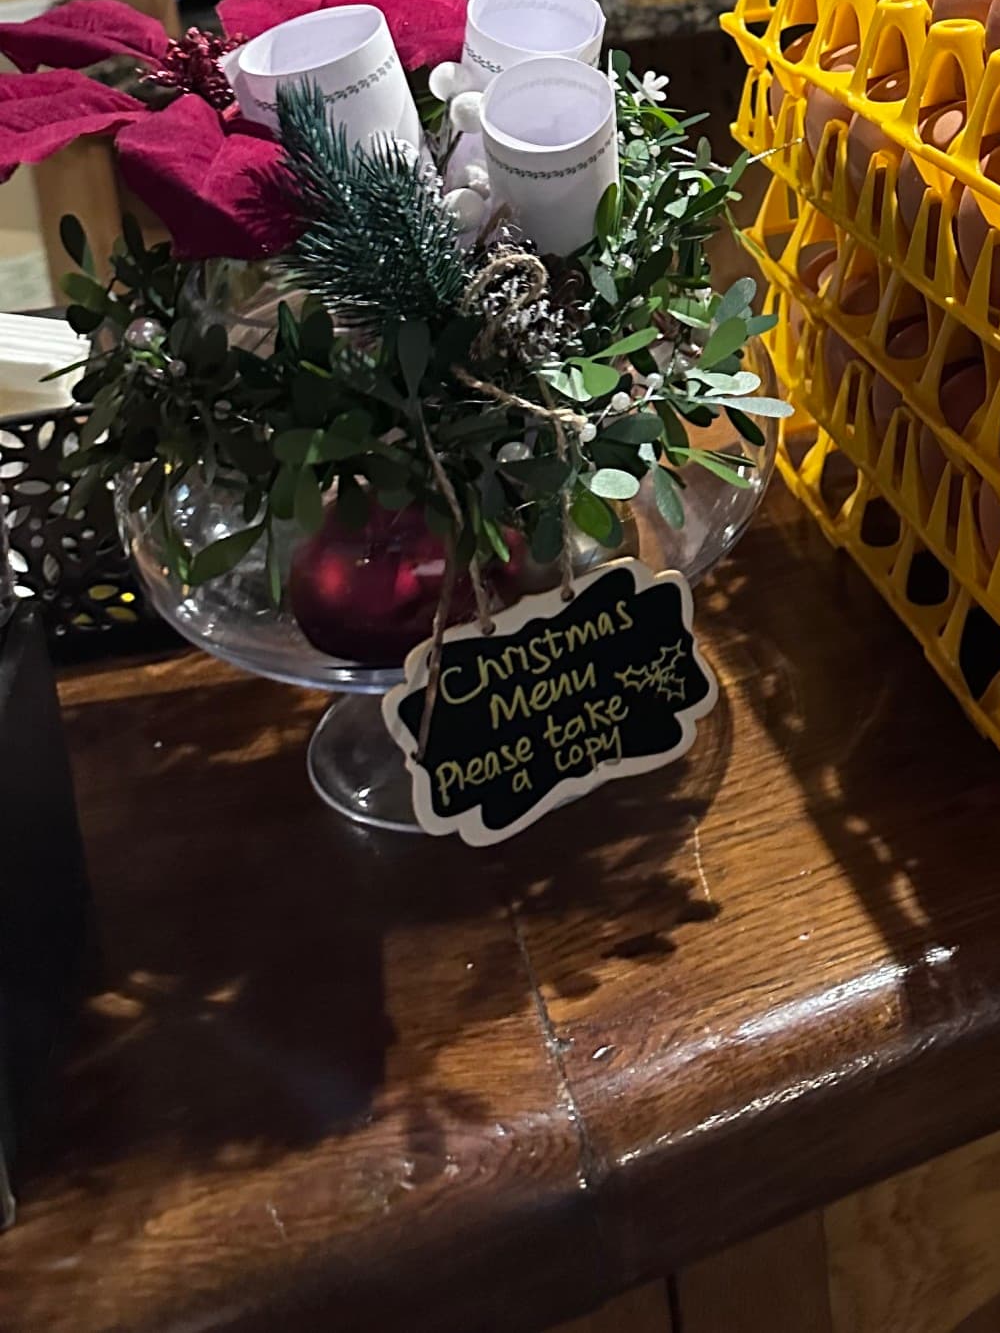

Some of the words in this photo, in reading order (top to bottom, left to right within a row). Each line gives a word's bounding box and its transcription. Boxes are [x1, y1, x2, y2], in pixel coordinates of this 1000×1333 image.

[440, 600, 634, 704] Christmas
[489, 662, 597, 730] Menu
[543, 695, 629, 748] take
[511, 768, 533, 793] a
[554, 725, 623, 772] copy
